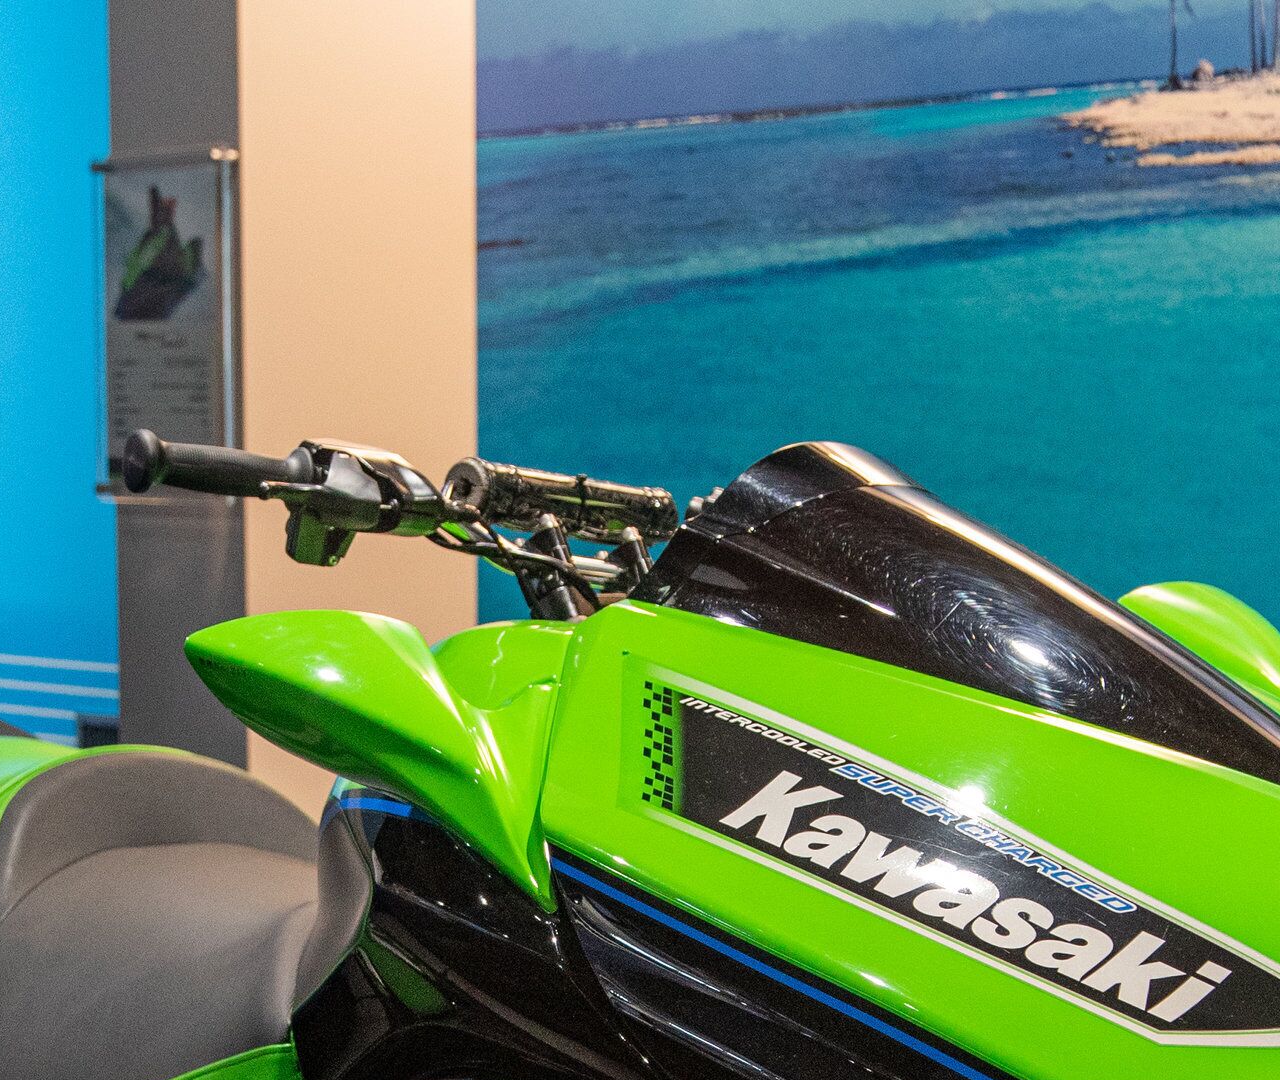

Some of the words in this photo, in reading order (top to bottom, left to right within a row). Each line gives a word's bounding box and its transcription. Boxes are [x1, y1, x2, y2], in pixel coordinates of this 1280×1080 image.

[679, 697, 846, 766] INTERCOOLED
[830, 762, 959, 825] SUPER
[954, 820, 1138, 914] CHARGED
[720, 771, 1231, 1022] Kawasaki
